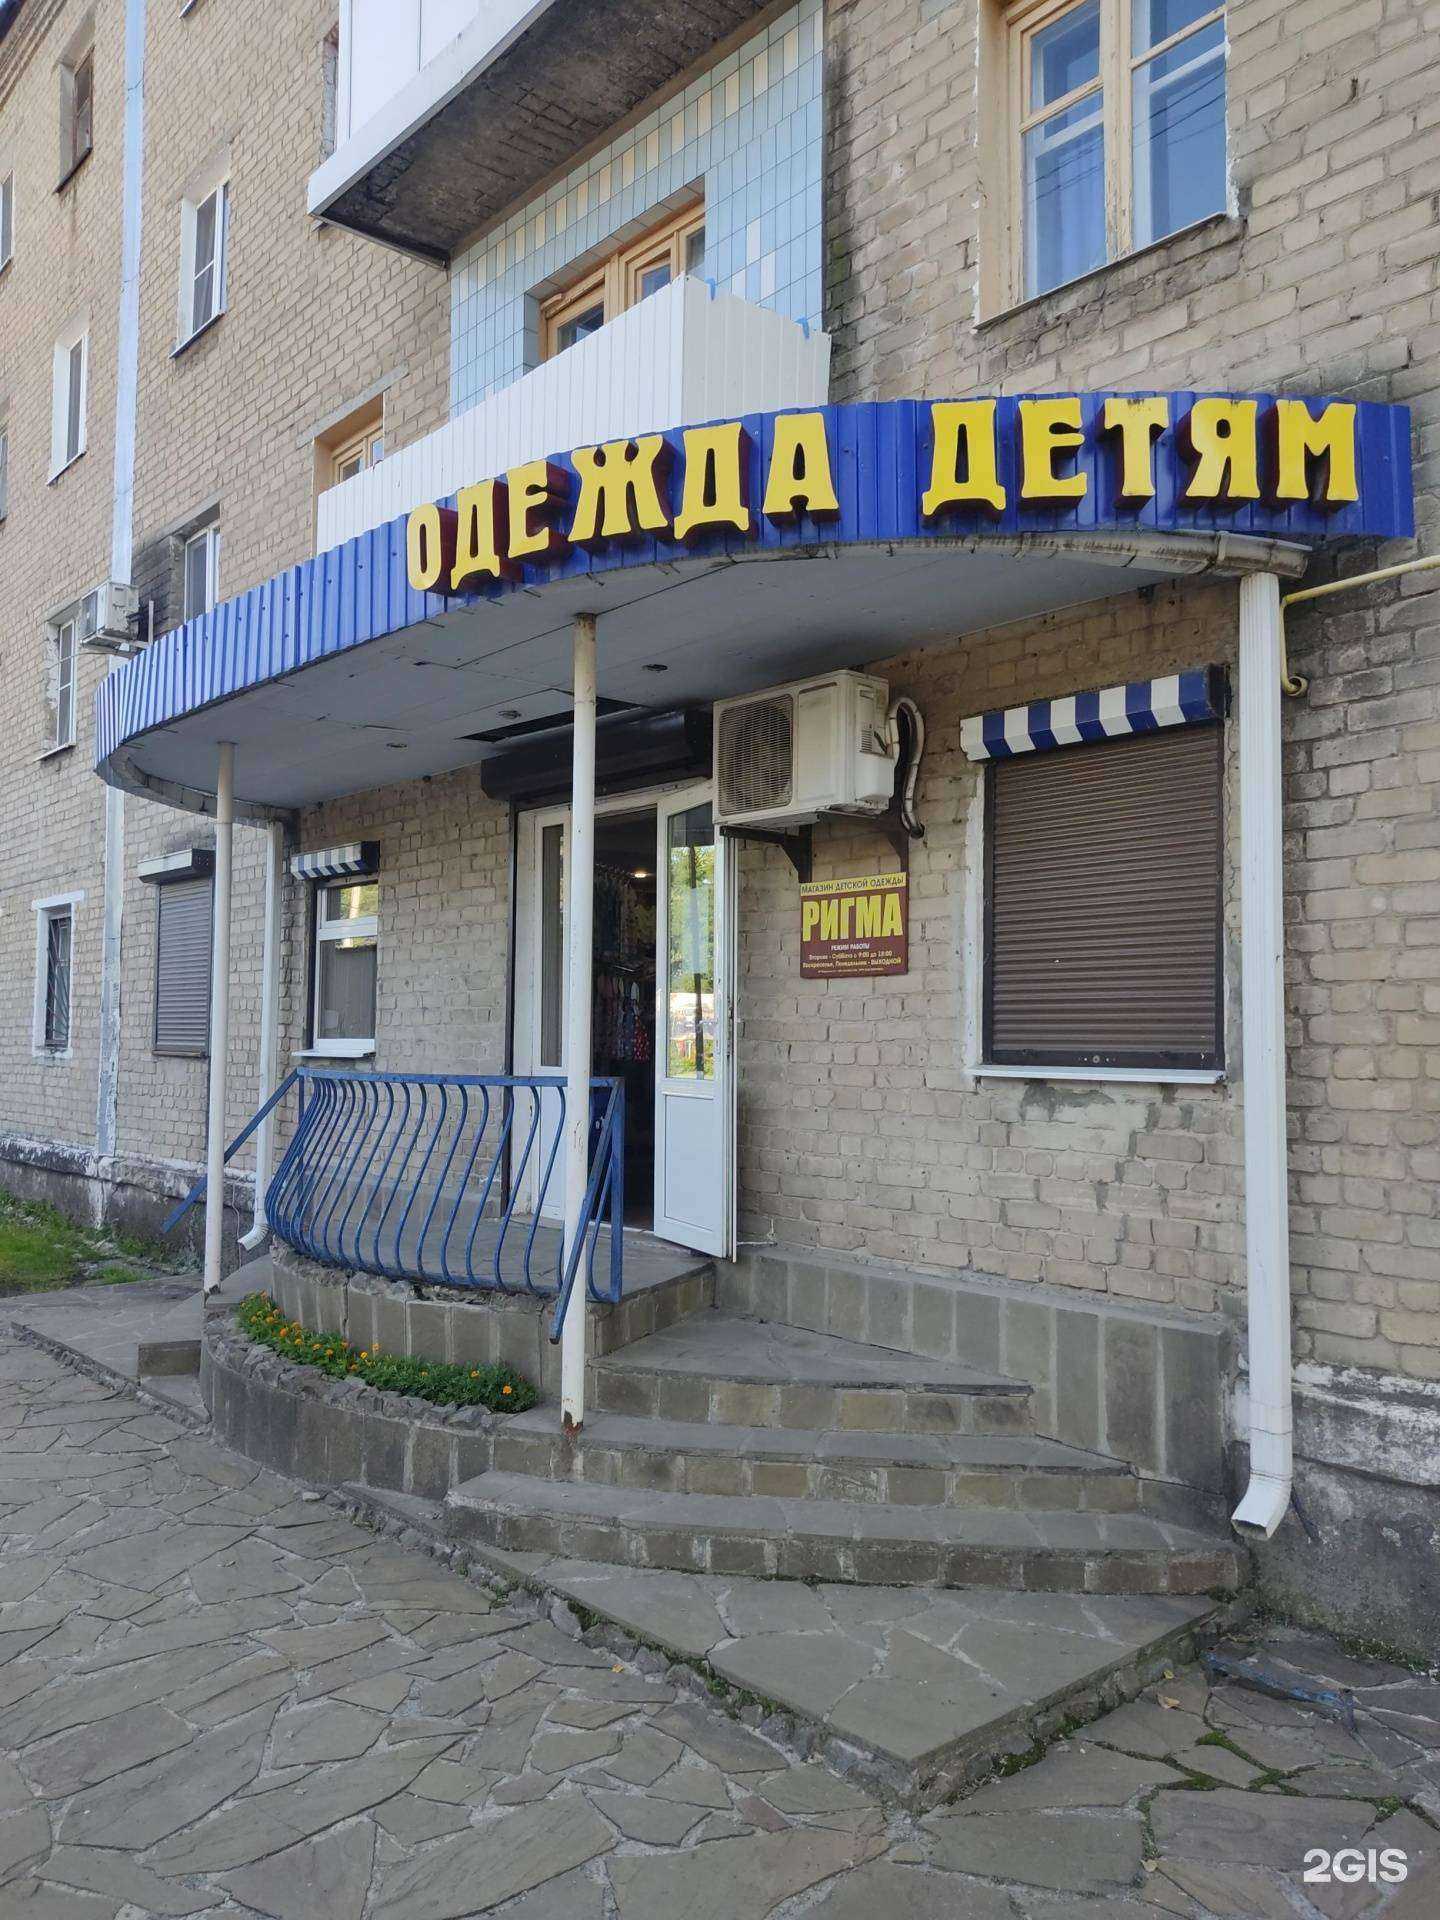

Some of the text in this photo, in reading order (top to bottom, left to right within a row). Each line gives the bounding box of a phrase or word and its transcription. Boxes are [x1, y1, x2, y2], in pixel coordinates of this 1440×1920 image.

[406, 397, 1359, 591] ОДЕЖДА ДЕТЯМ
[801, 876, 904, 894] МАГАЗИН ДЕТСКОЙ ОДЕЖДЫ
[802, 893, 904, 942] РИГМА
